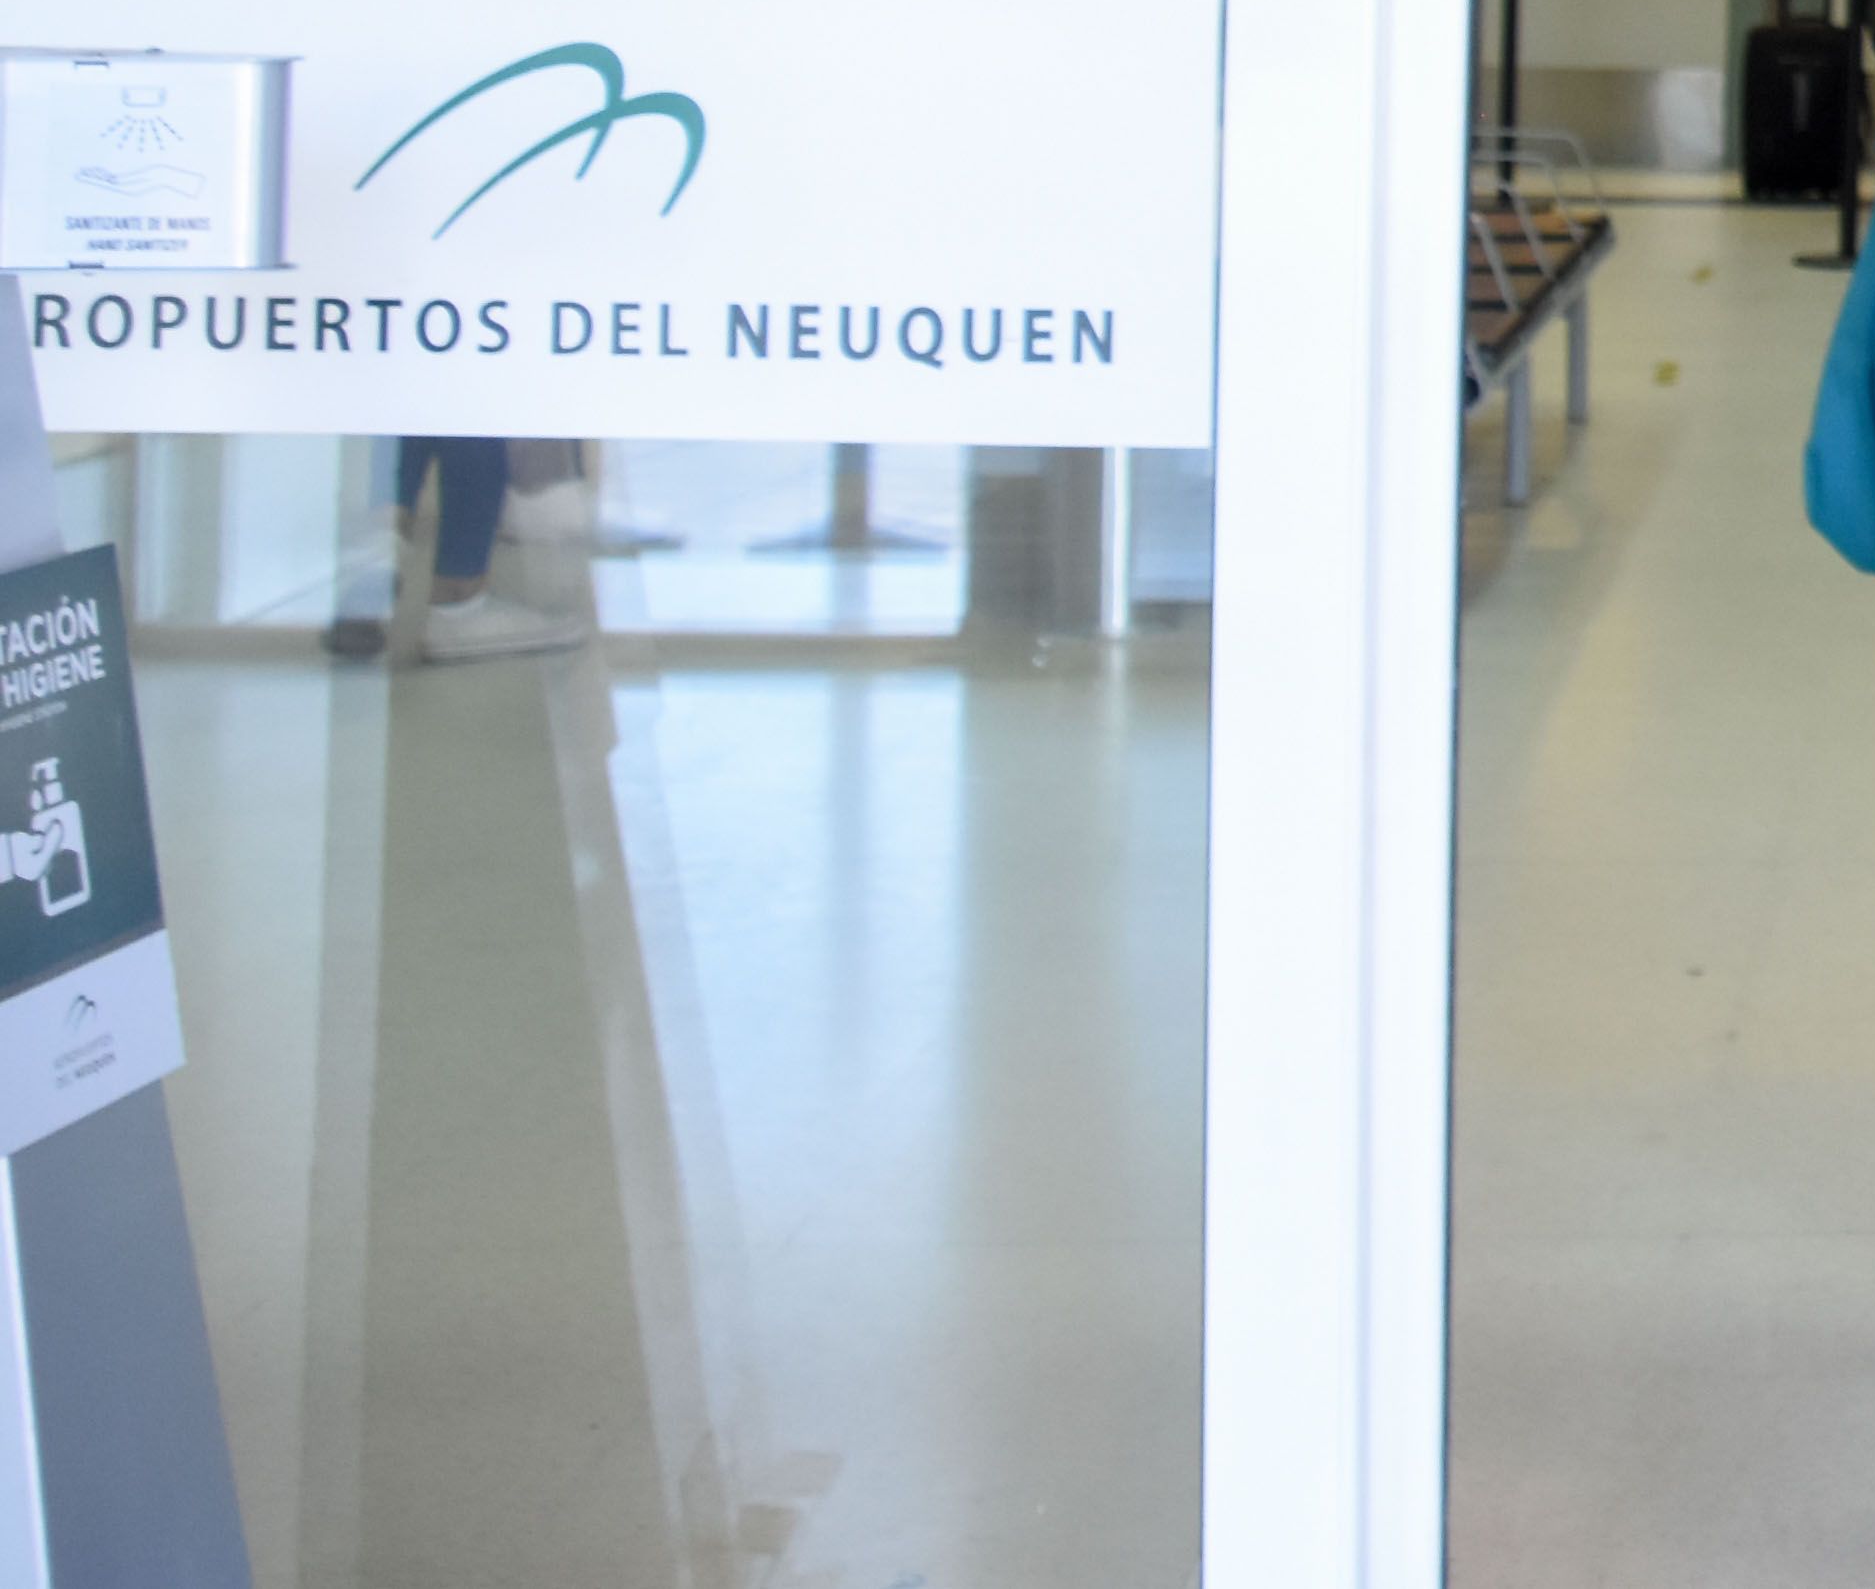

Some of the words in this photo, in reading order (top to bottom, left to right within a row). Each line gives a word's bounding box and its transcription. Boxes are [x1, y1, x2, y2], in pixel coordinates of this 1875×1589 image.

[33, 294, 511, 356] ROPUERTOS
[551, 302, 690, 358] DEL
[727, 304, 1115, 370] NEUQUEN
[1, 643, 107, 709] HIGIENE
